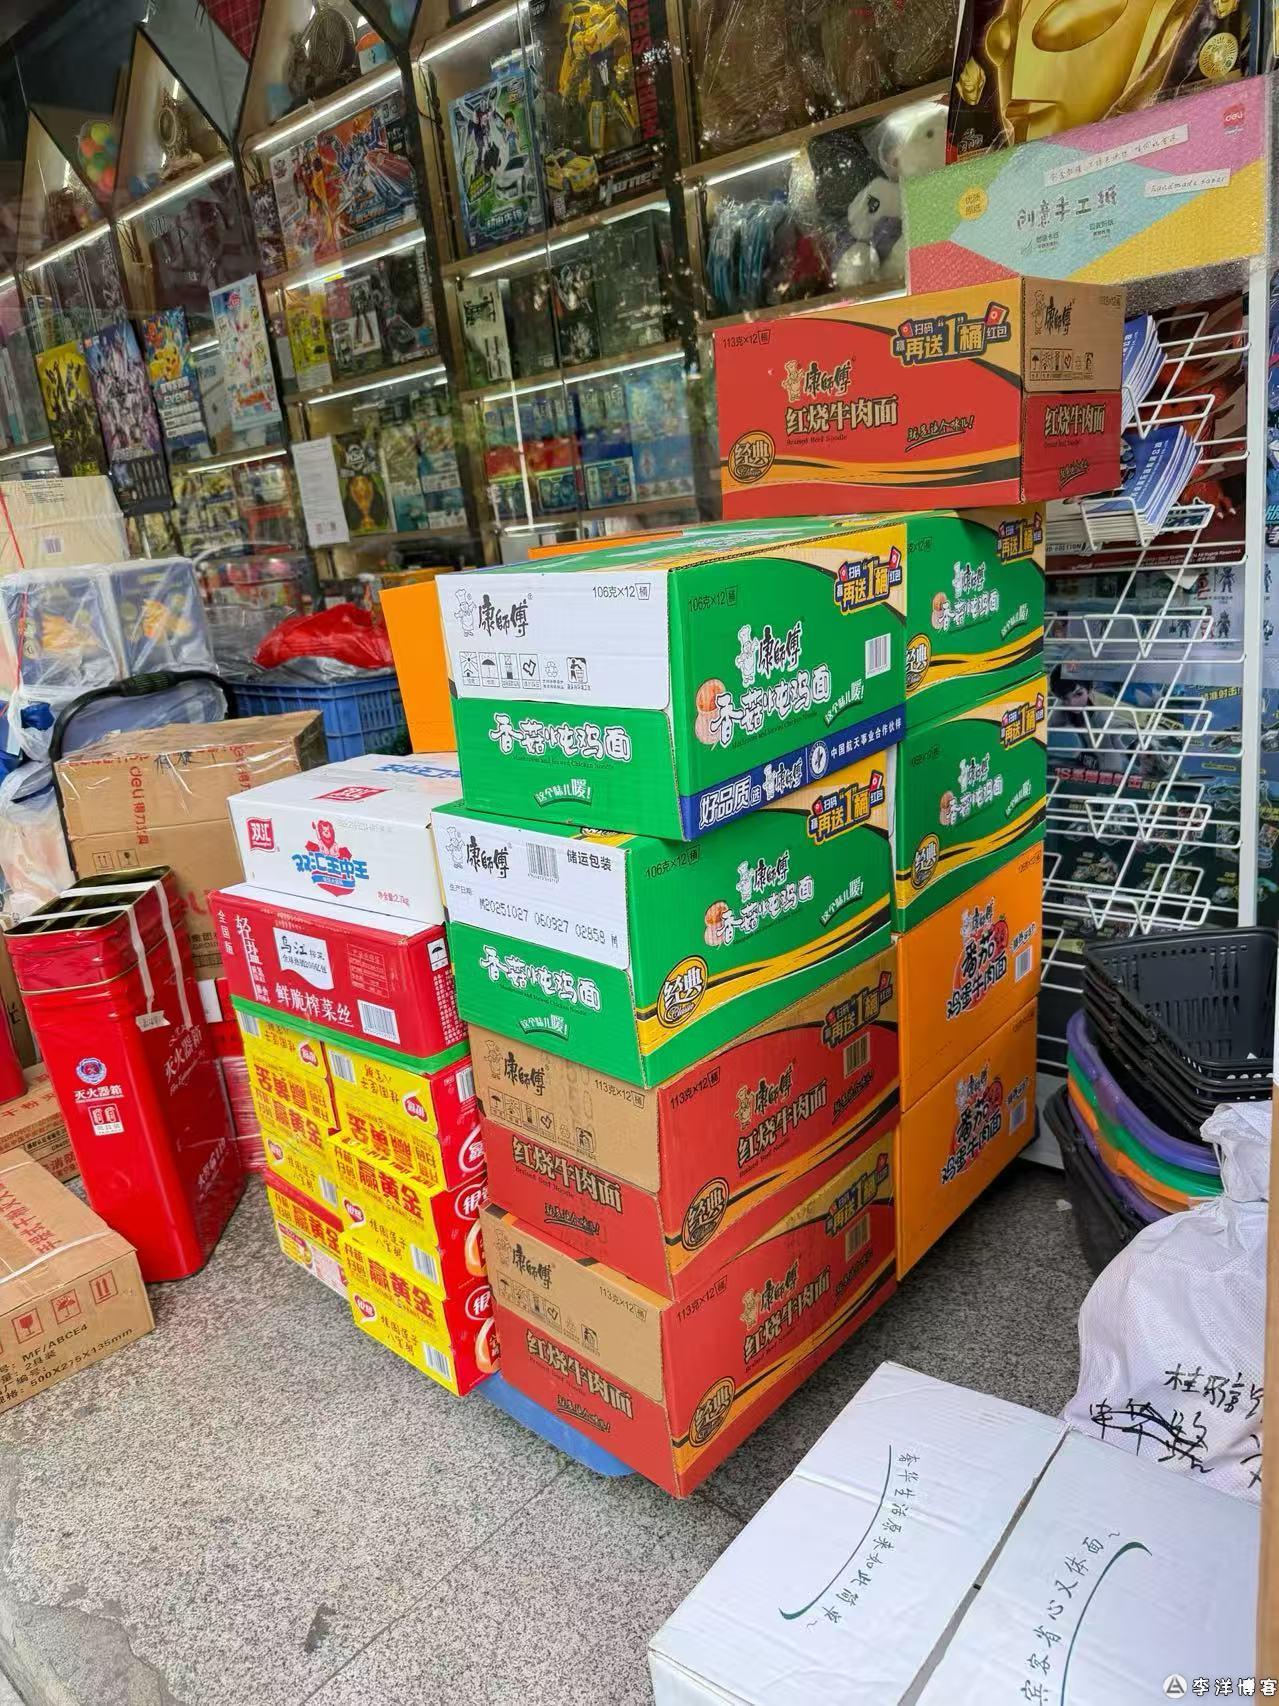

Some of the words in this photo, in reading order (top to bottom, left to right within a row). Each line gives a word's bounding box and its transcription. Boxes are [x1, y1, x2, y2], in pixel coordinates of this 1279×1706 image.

[785, 394, 899, 436] 红烧牛肉面
[1044, 403, 1106, 436] 红烧牛肉面
[734, 440, 771, 467] 经典
[709, 663, 831, 748] 香菇炖鸡面
[489, 713, 632, 762] 香菇炖鸡面
[831, 717, 901, 759] 中国航天事业合作伙伴
[129, 766, 145, 799] deli
[700, 776, 752, 829] 好品质
[251, 822, 272, 842] 双汇
[291, 851, 370, 881] 双汇王中王
[567, 849, 612, 871] 储运包装
[716, 875, 814, 945] 香菇炖鸡面
[281, 935, 307, 955] 乌江
[961, 934, 996, 979] 番茄
[480, 944, 601, 1012] 香菇炖鸡面
[664, 966, 702, 1010] 经典
[946, 950, 1006, 1020] 鸡蛋牛肉面
[276, 982, 352, 1024] 鲜脆榨菜丝
[74, 1085, 122, 1100] 灭火器箱
[737, 1077, 828, 1168] 红烧牛肉面
[942, 1110, 1002, 1184] 鸡蛋牛肉面
[358, 1160, 424, 1220] 赢黄金
[513, 1134, 623, 1214] 红烧牛肉面
[0, 1177, 62, 1253] 手提式干粉灭火
[687, 1183, 725, 1230] 经典
[368, 1258, 435, 1320] 赢黄金
[744, 1266, 830, 1363] 红烧牛肉面
[22, 1324, 88, 1363] MF/ABCE4
[526, 1329, 634, 1420] 红烧牛肉面
[694, 1384, 730, 1430] 经典
